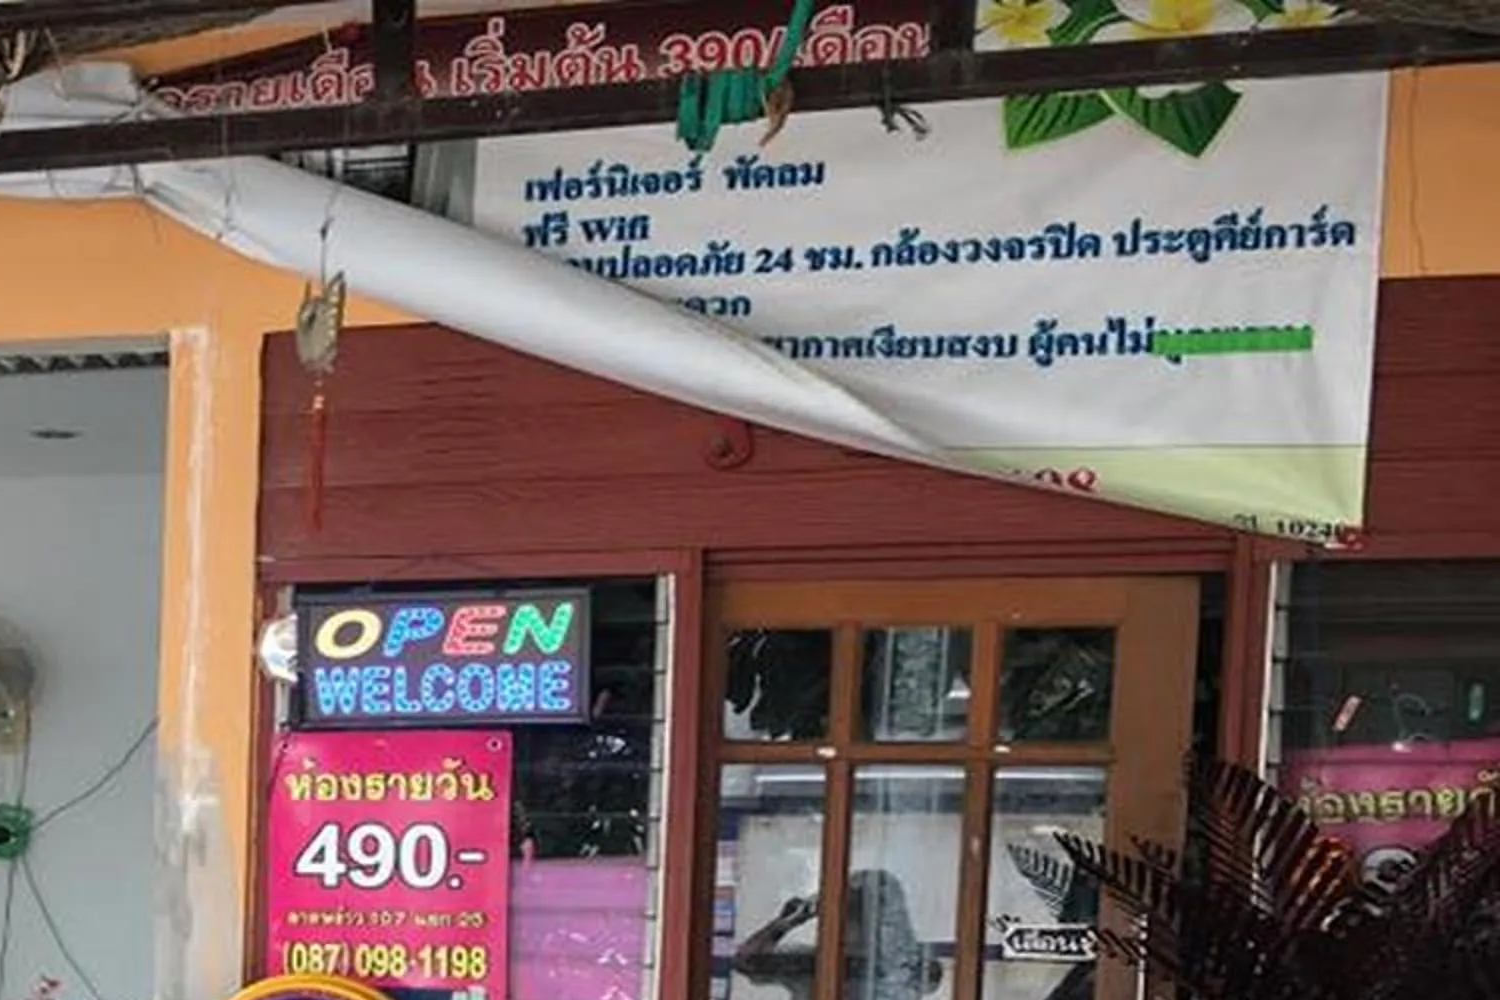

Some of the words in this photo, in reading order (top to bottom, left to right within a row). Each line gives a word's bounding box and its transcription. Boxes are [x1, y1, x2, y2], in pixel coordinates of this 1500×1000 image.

[450, 16, 647, 96] เริ่มต้น
[524, 155, 704, 202] เฟอร์นิเจอร์
[722, 154, 826, 191] พัดลม
[522, 211, 570, 248] ฟรี
[580, 214, 651, 243] Wifi
[754, 248, 793, 274] 24
[802, 244, 863, 272] ชม.
[870, 221, 1101, 267] กล้องวงจรปิด
[1112, 205, 1357, 263] ประตูคีย์การ์ด
[313, 602, 575, 658] OPEN
[314, 660, 573, 715] WELCOME
[284, 756, 498, 802] ห้องรายวัน
[293, 819, 489, 890] 490.-
[282, 940, 350, 977] (087)
[354, 942, 488, 980] 098-1198
